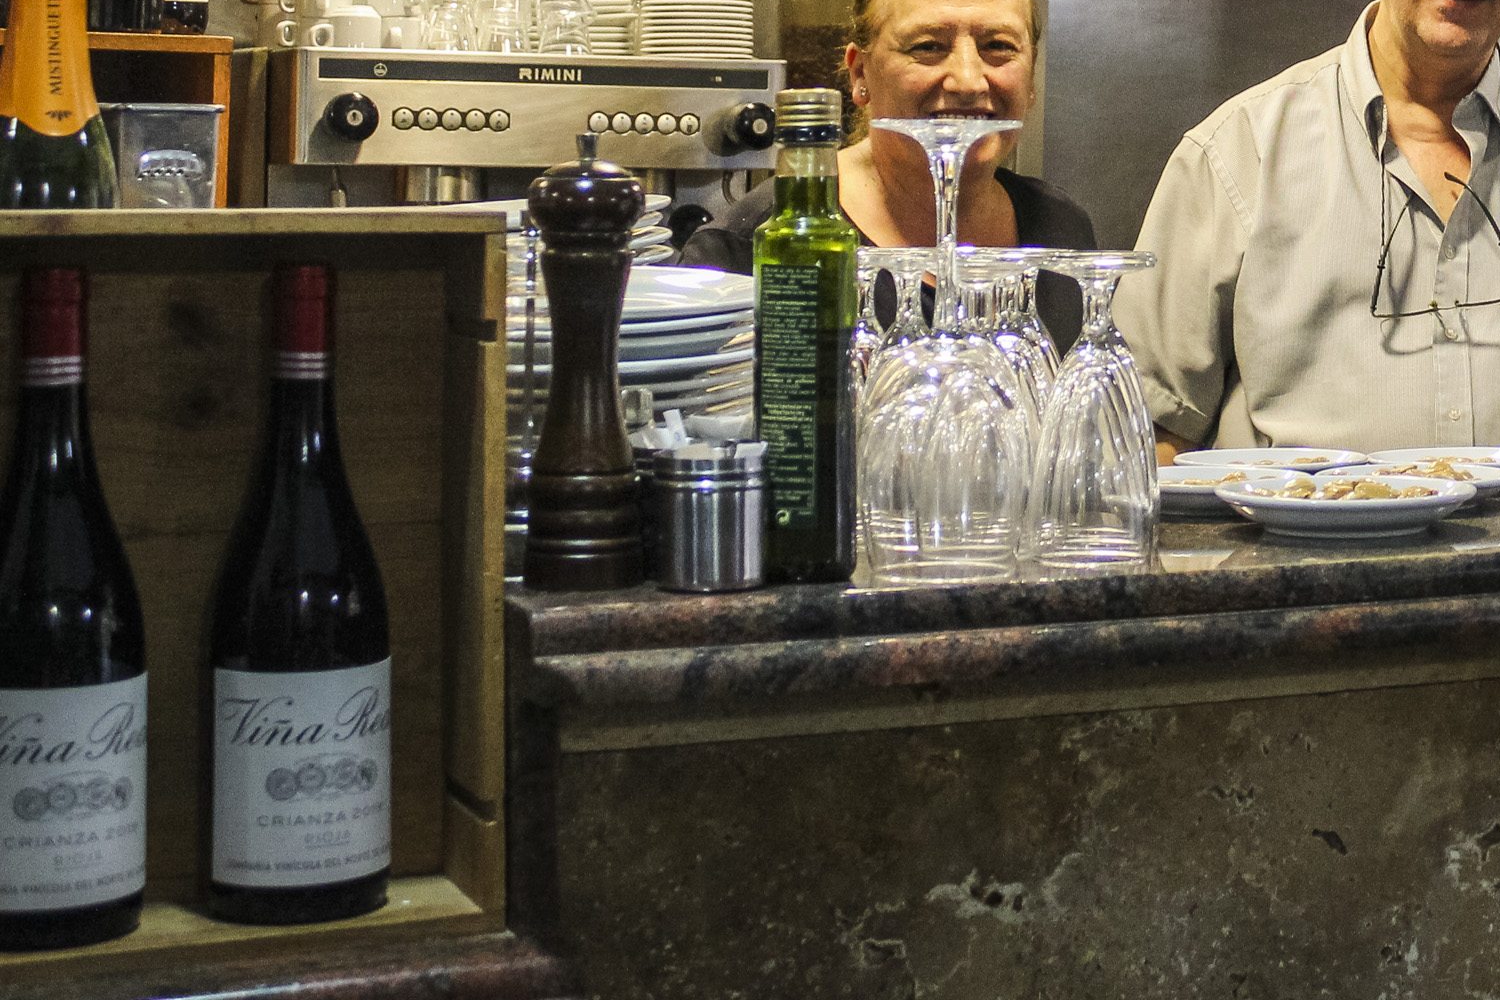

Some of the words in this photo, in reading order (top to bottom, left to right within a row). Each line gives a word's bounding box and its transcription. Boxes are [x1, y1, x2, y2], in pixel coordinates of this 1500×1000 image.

[518, 67, 583, 83] RIMINI
[220, 695, 328, 747] Viña
[256, 809, 347, 828] CRIANZA
[3, 831, 99, 848] CRIANZA
